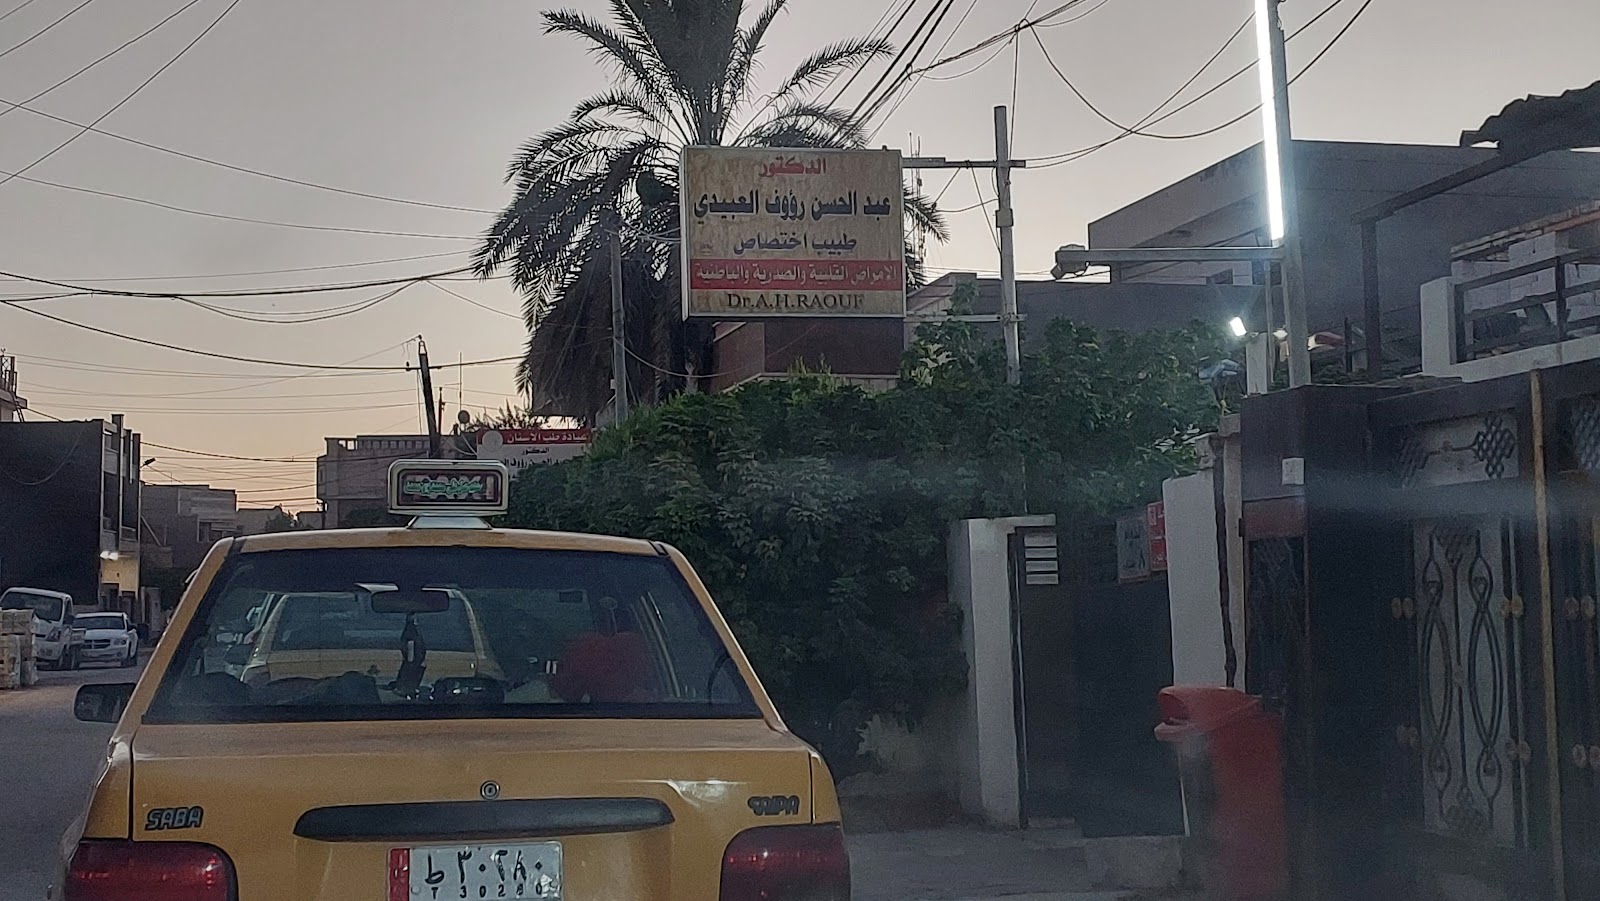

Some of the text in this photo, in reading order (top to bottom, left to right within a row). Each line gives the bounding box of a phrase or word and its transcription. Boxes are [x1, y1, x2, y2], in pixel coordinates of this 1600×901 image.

[758, 155, 827, 177] الدكتور
[693, 189, 891, 224] عبد الحسن رؤوف العبيدي
[733, 232, 807, 255] اختصاص
[811, 232, 857, 255] طبيب
[695, 263, 896, 286] الامراض القلبية والصدرية والباطنية
[521, 447, 550, 456] الدكتور
[144, 806, 204, 831] SABA
[424, 853, 445, 885] ط
[430, 886, 440, 900] T
